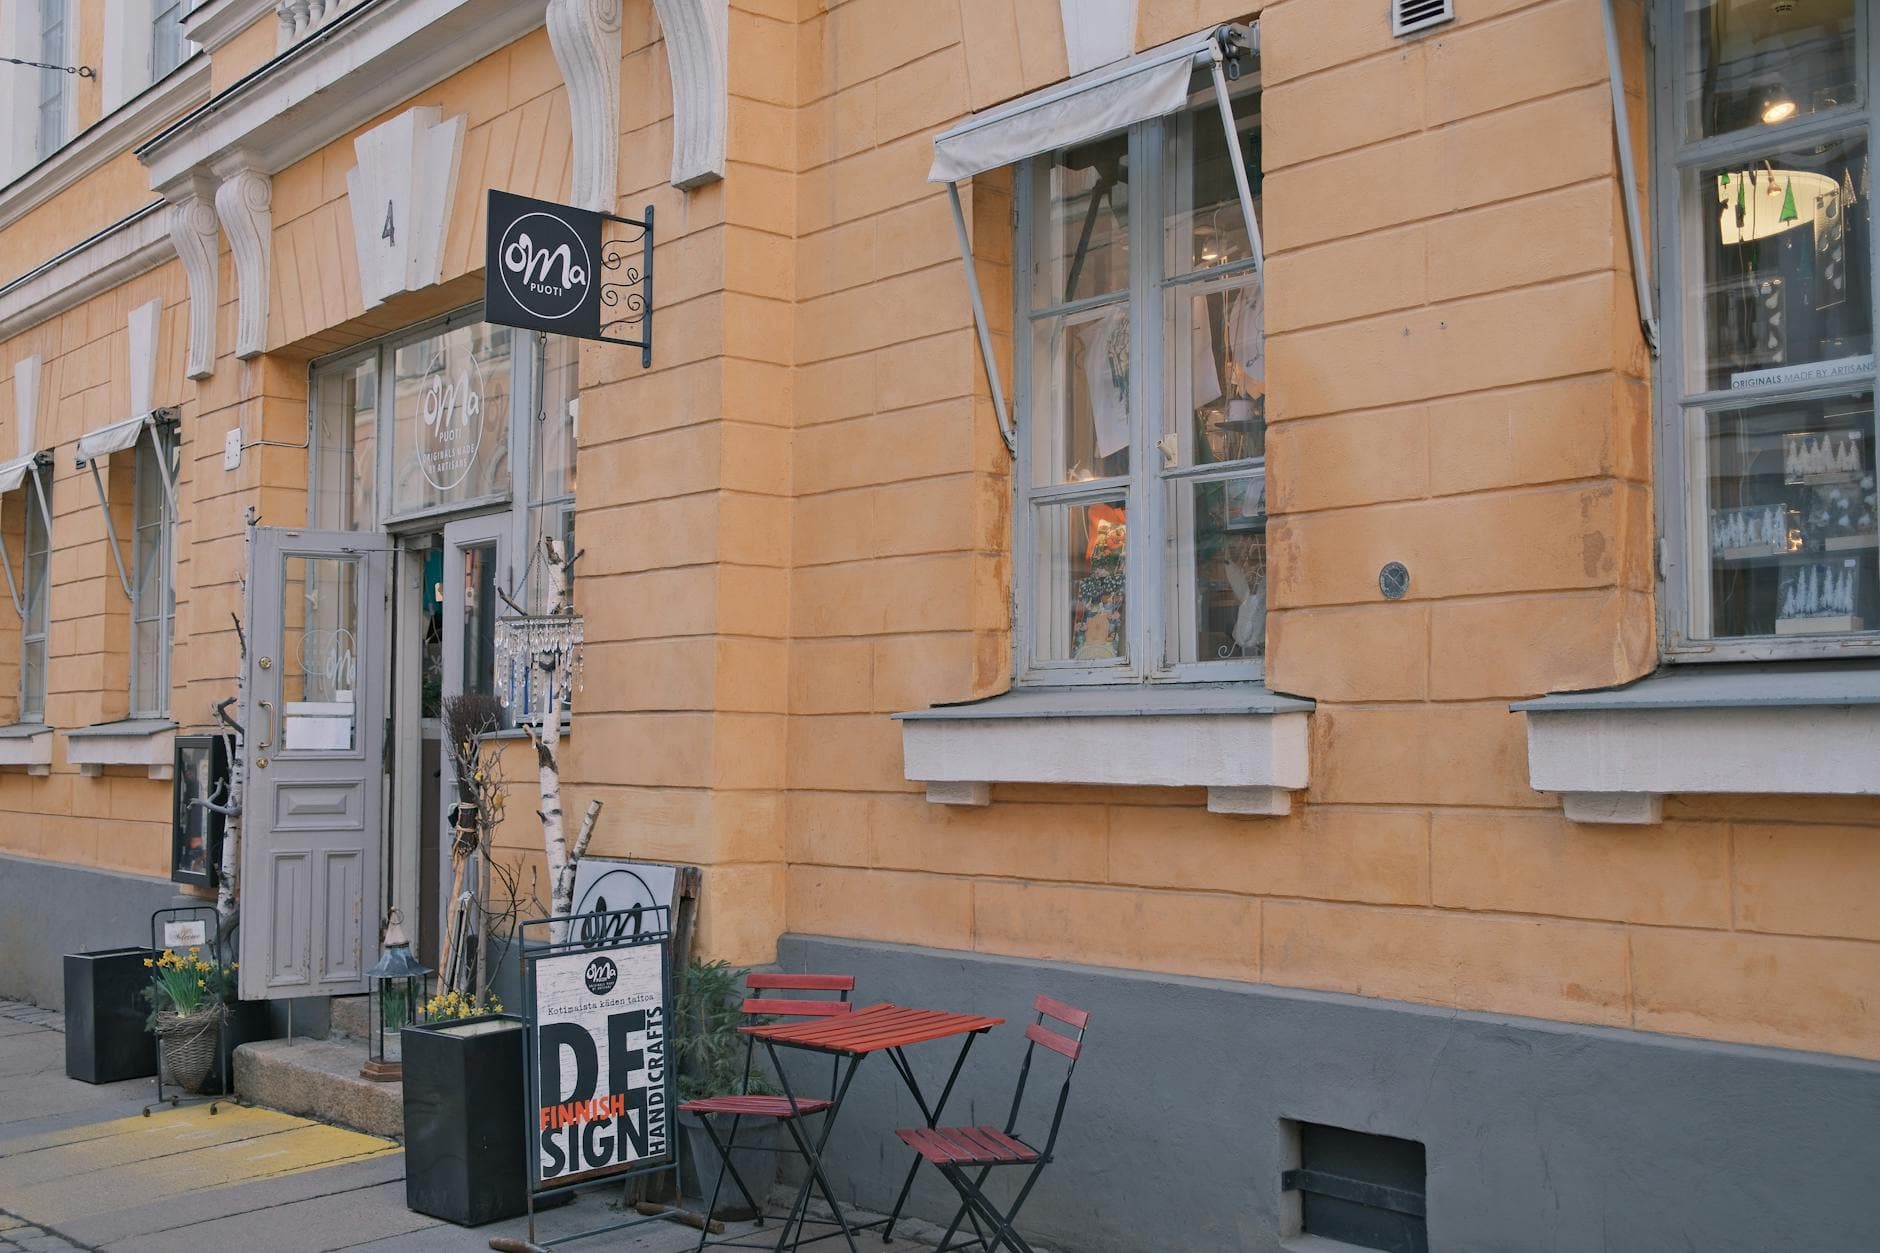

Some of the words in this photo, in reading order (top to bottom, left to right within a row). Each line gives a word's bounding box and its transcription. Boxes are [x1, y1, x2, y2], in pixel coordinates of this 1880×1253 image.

[381, 199, 395, 247] 4
[530, 282, 562, 297] PUOTI
[1732, 374, 1782, 390] ORIGINALS
[1784, 372, 1813, 382] MADE
[1816, 368, 1828, 378] BY
[439, 429, 462, 443] PUOTI
[548, 1003, 598, 1016] Kotimaista
[600, 998, 625, 1008] käden
[647, 1006, 665, 1156] HANDICRAFTS
[540, 1093, 625, 1130] FINNISH
[541, 1108, 649, 1178] SIGN
